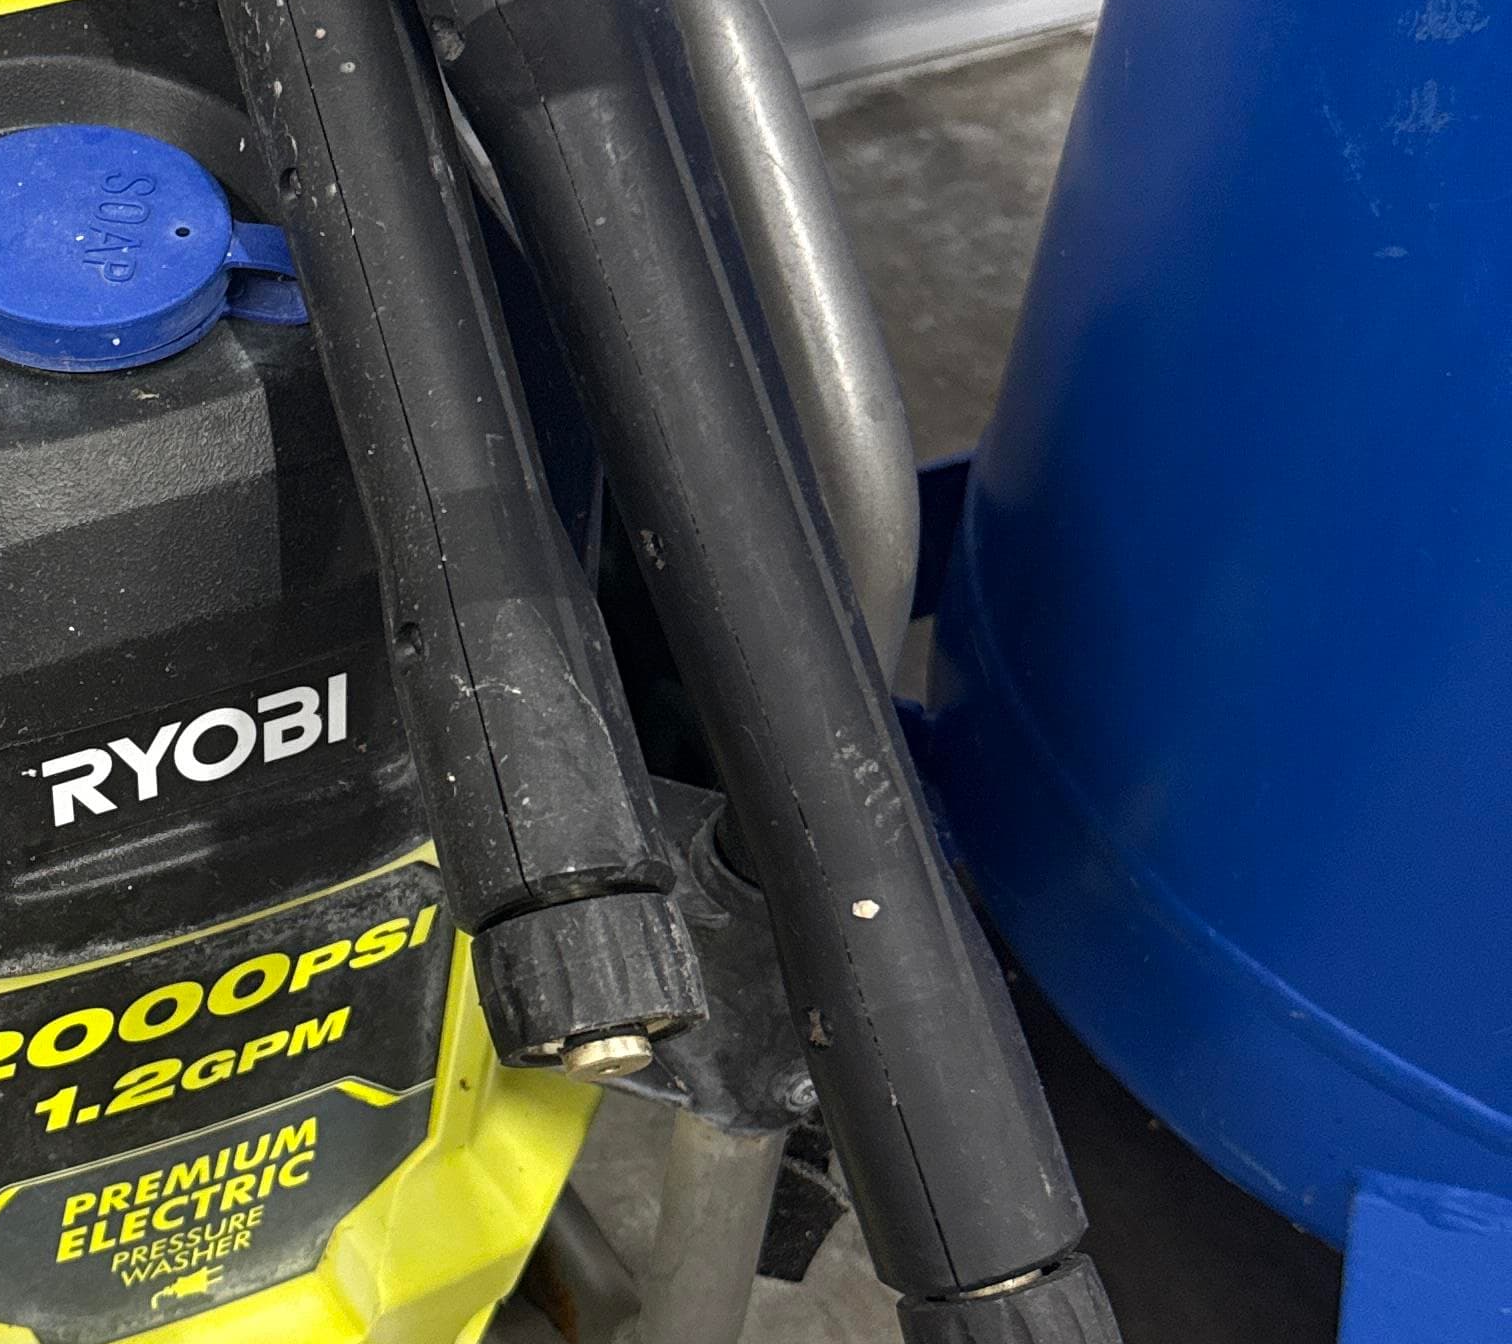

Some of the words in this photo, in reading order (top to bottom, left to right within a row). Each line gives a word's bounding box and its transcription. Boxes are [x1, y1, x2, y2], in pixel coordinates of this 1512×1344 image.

[83, 173, 157, 283] SOAP
[42, 673, 347, 827] RYOBI
[34, 1006, 352, 1132] 1.2GPM
[56, 1150, 315, 1263] ELECTRIC
[62, 1117, 317, 1227] PREMIUM
[111, 1205, 264, 1272] PRESSURE
[121, 1230, 251, 1287] WASHER
